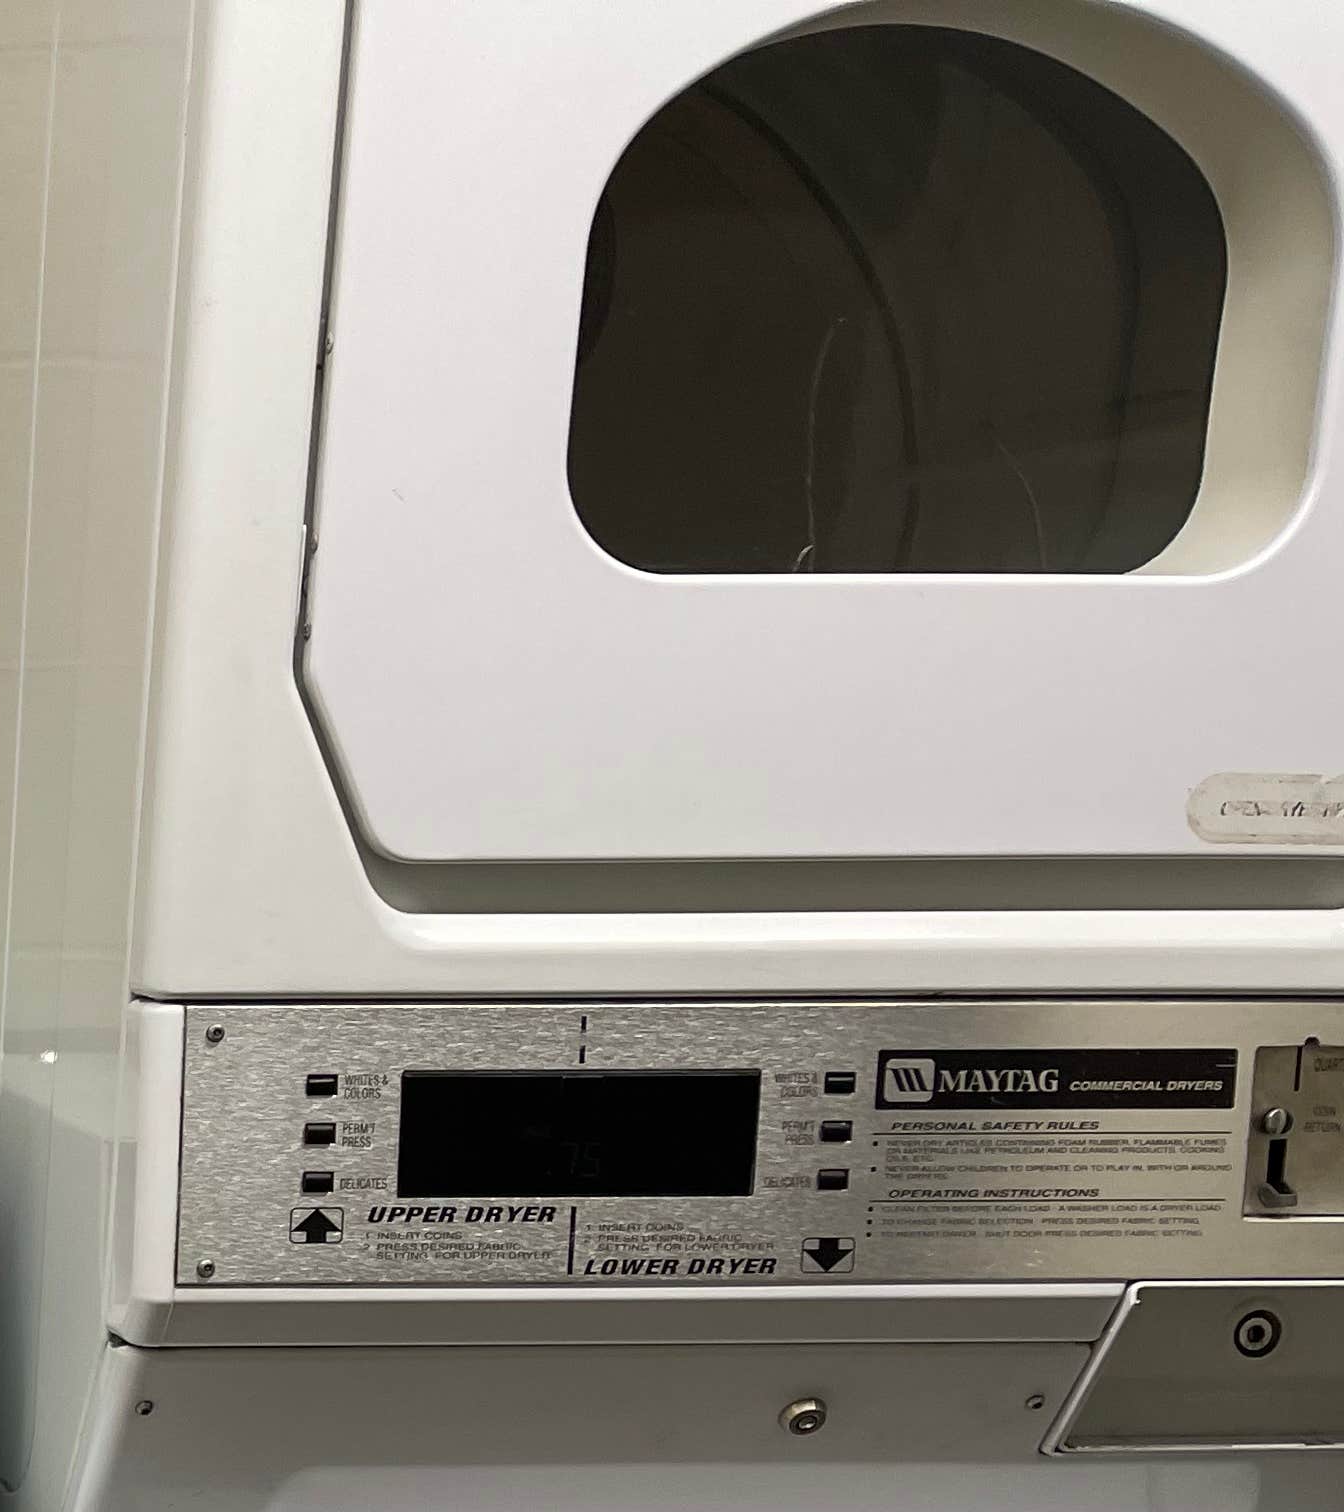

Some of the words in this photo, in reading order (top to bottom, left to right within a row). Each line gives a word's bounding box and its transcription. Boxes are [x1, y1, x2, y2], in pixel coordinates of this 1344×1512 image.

[938, 1069, 1059, 1093] MAYTAG
[1069, 1080, 1163, 1091] COMMERCIAL
[1166, 1080, 1223, 1091] DRYERS
[344, 1088, 381, 1099] COLORS
[891, 1121, 977, 1131] PERSONAL
[982, 1121, 1041, 1131] SAFETY
[1046, 1120, 1100, 1131] RULES
[342, 1137, 371, 1147] PRESS
[340, 1178, 387, 1190] DELICATES
[888, 1188, 979, 1199] OPERATING
[984, 1188, 1100, 1198] INSTRUCTIONS
[367, 1206, 461, 1224] UPPER
[465, 1206, 557, 1224] DRYER
[583, 1259, 683, 1276] LOWER
[687, 1258, 778, 1275] DRYER
